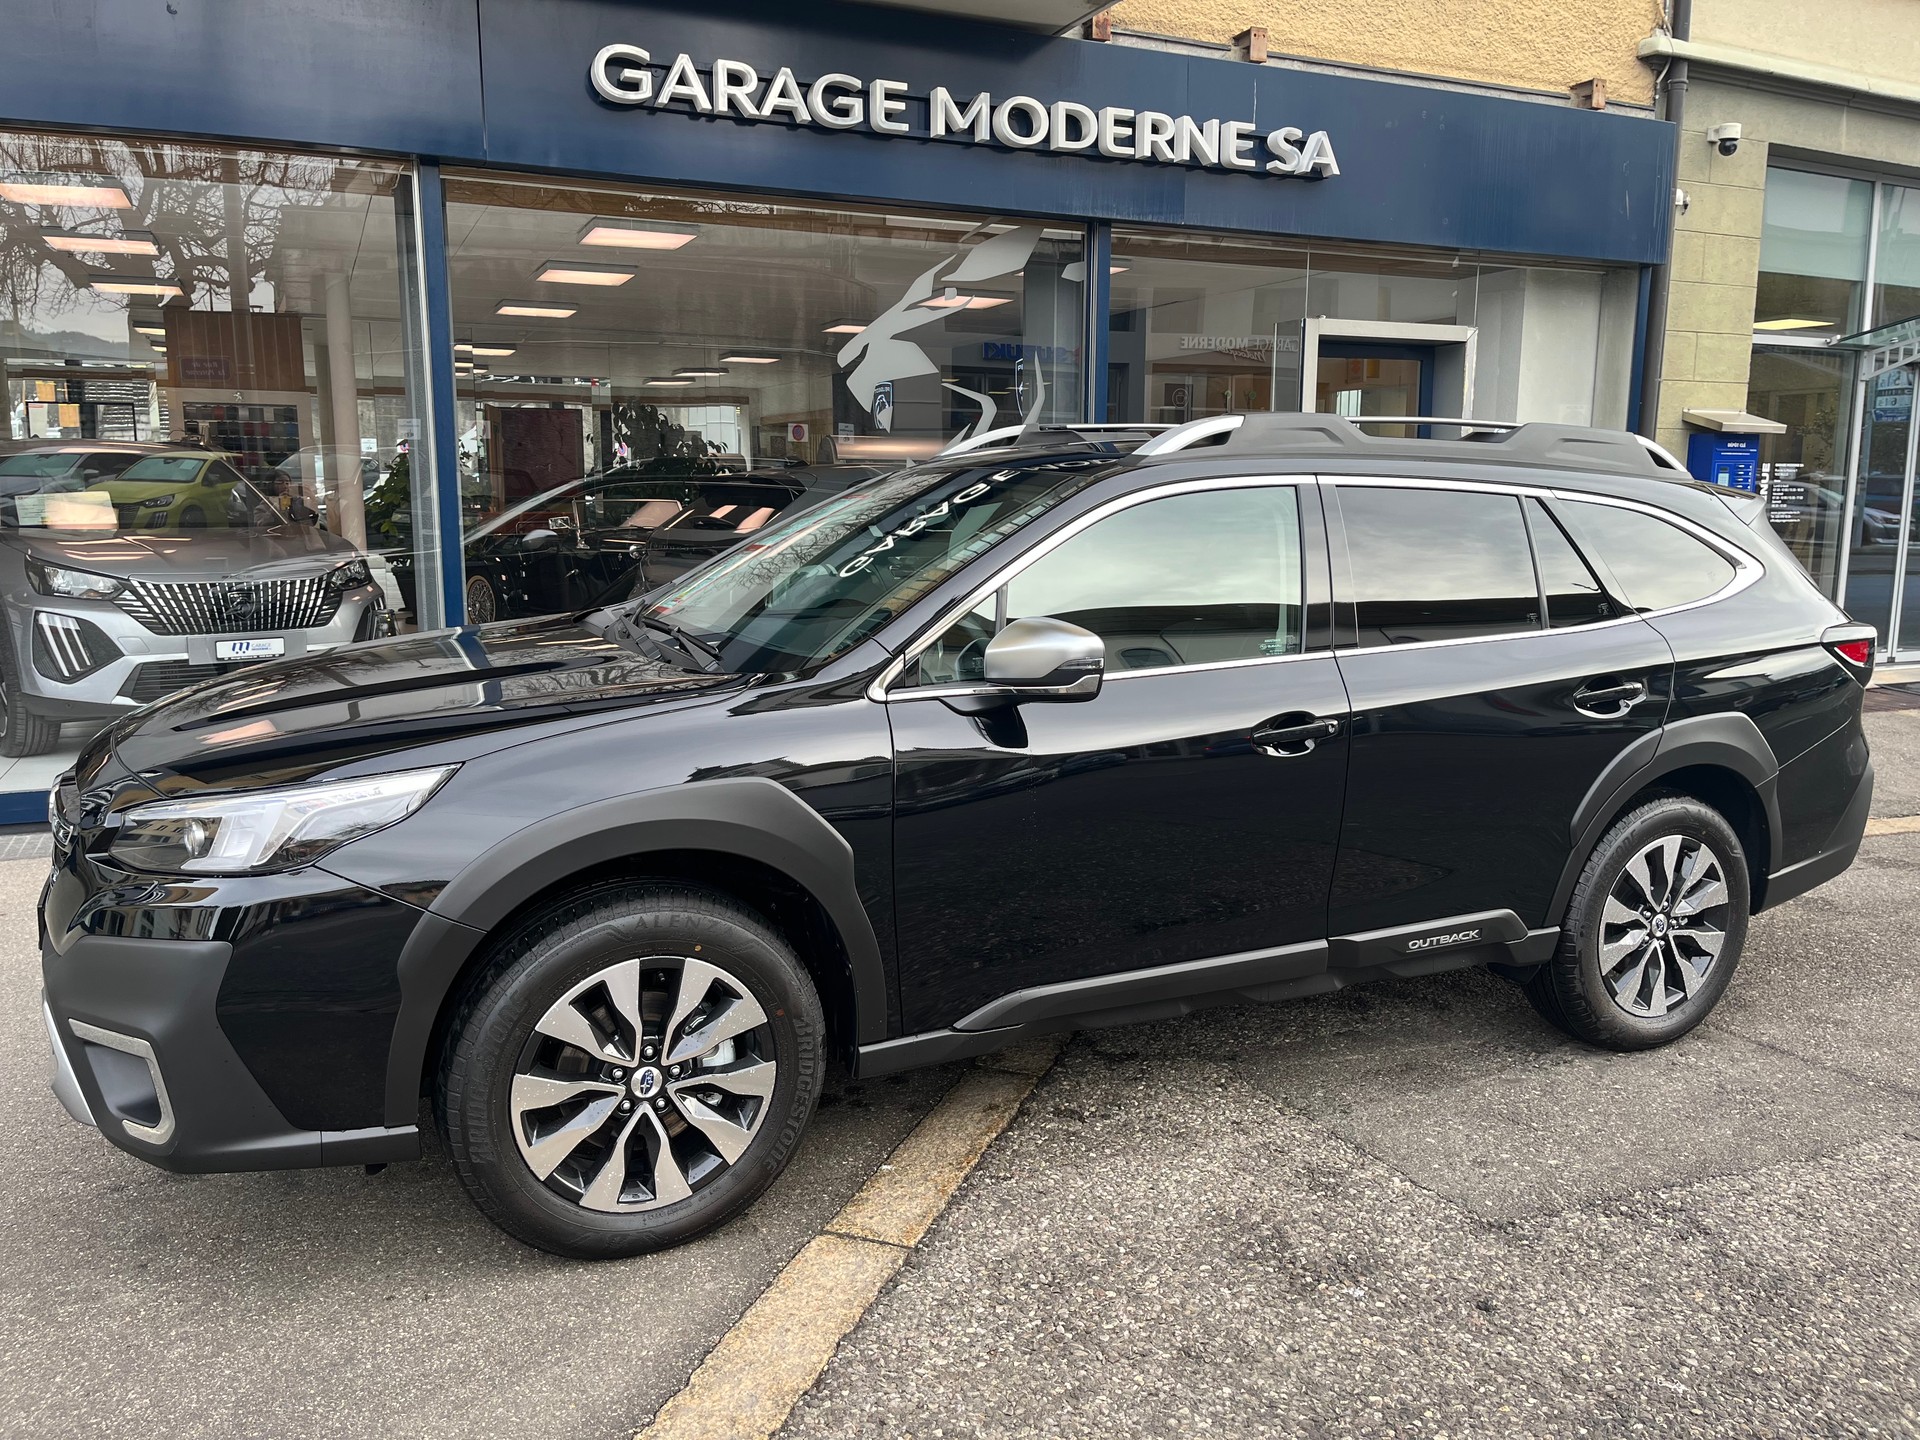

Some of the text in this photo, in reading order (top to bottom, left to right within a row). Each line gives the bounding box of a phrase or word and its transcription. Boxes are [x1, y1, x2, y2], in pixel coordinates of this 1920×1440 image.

[590, 43, 1341, 176] GARAGE MODERNE SA
[1408, 929, 1480, 949] OUTBACK
[764, 1016, 815, 1174] BRIDGESTONE
